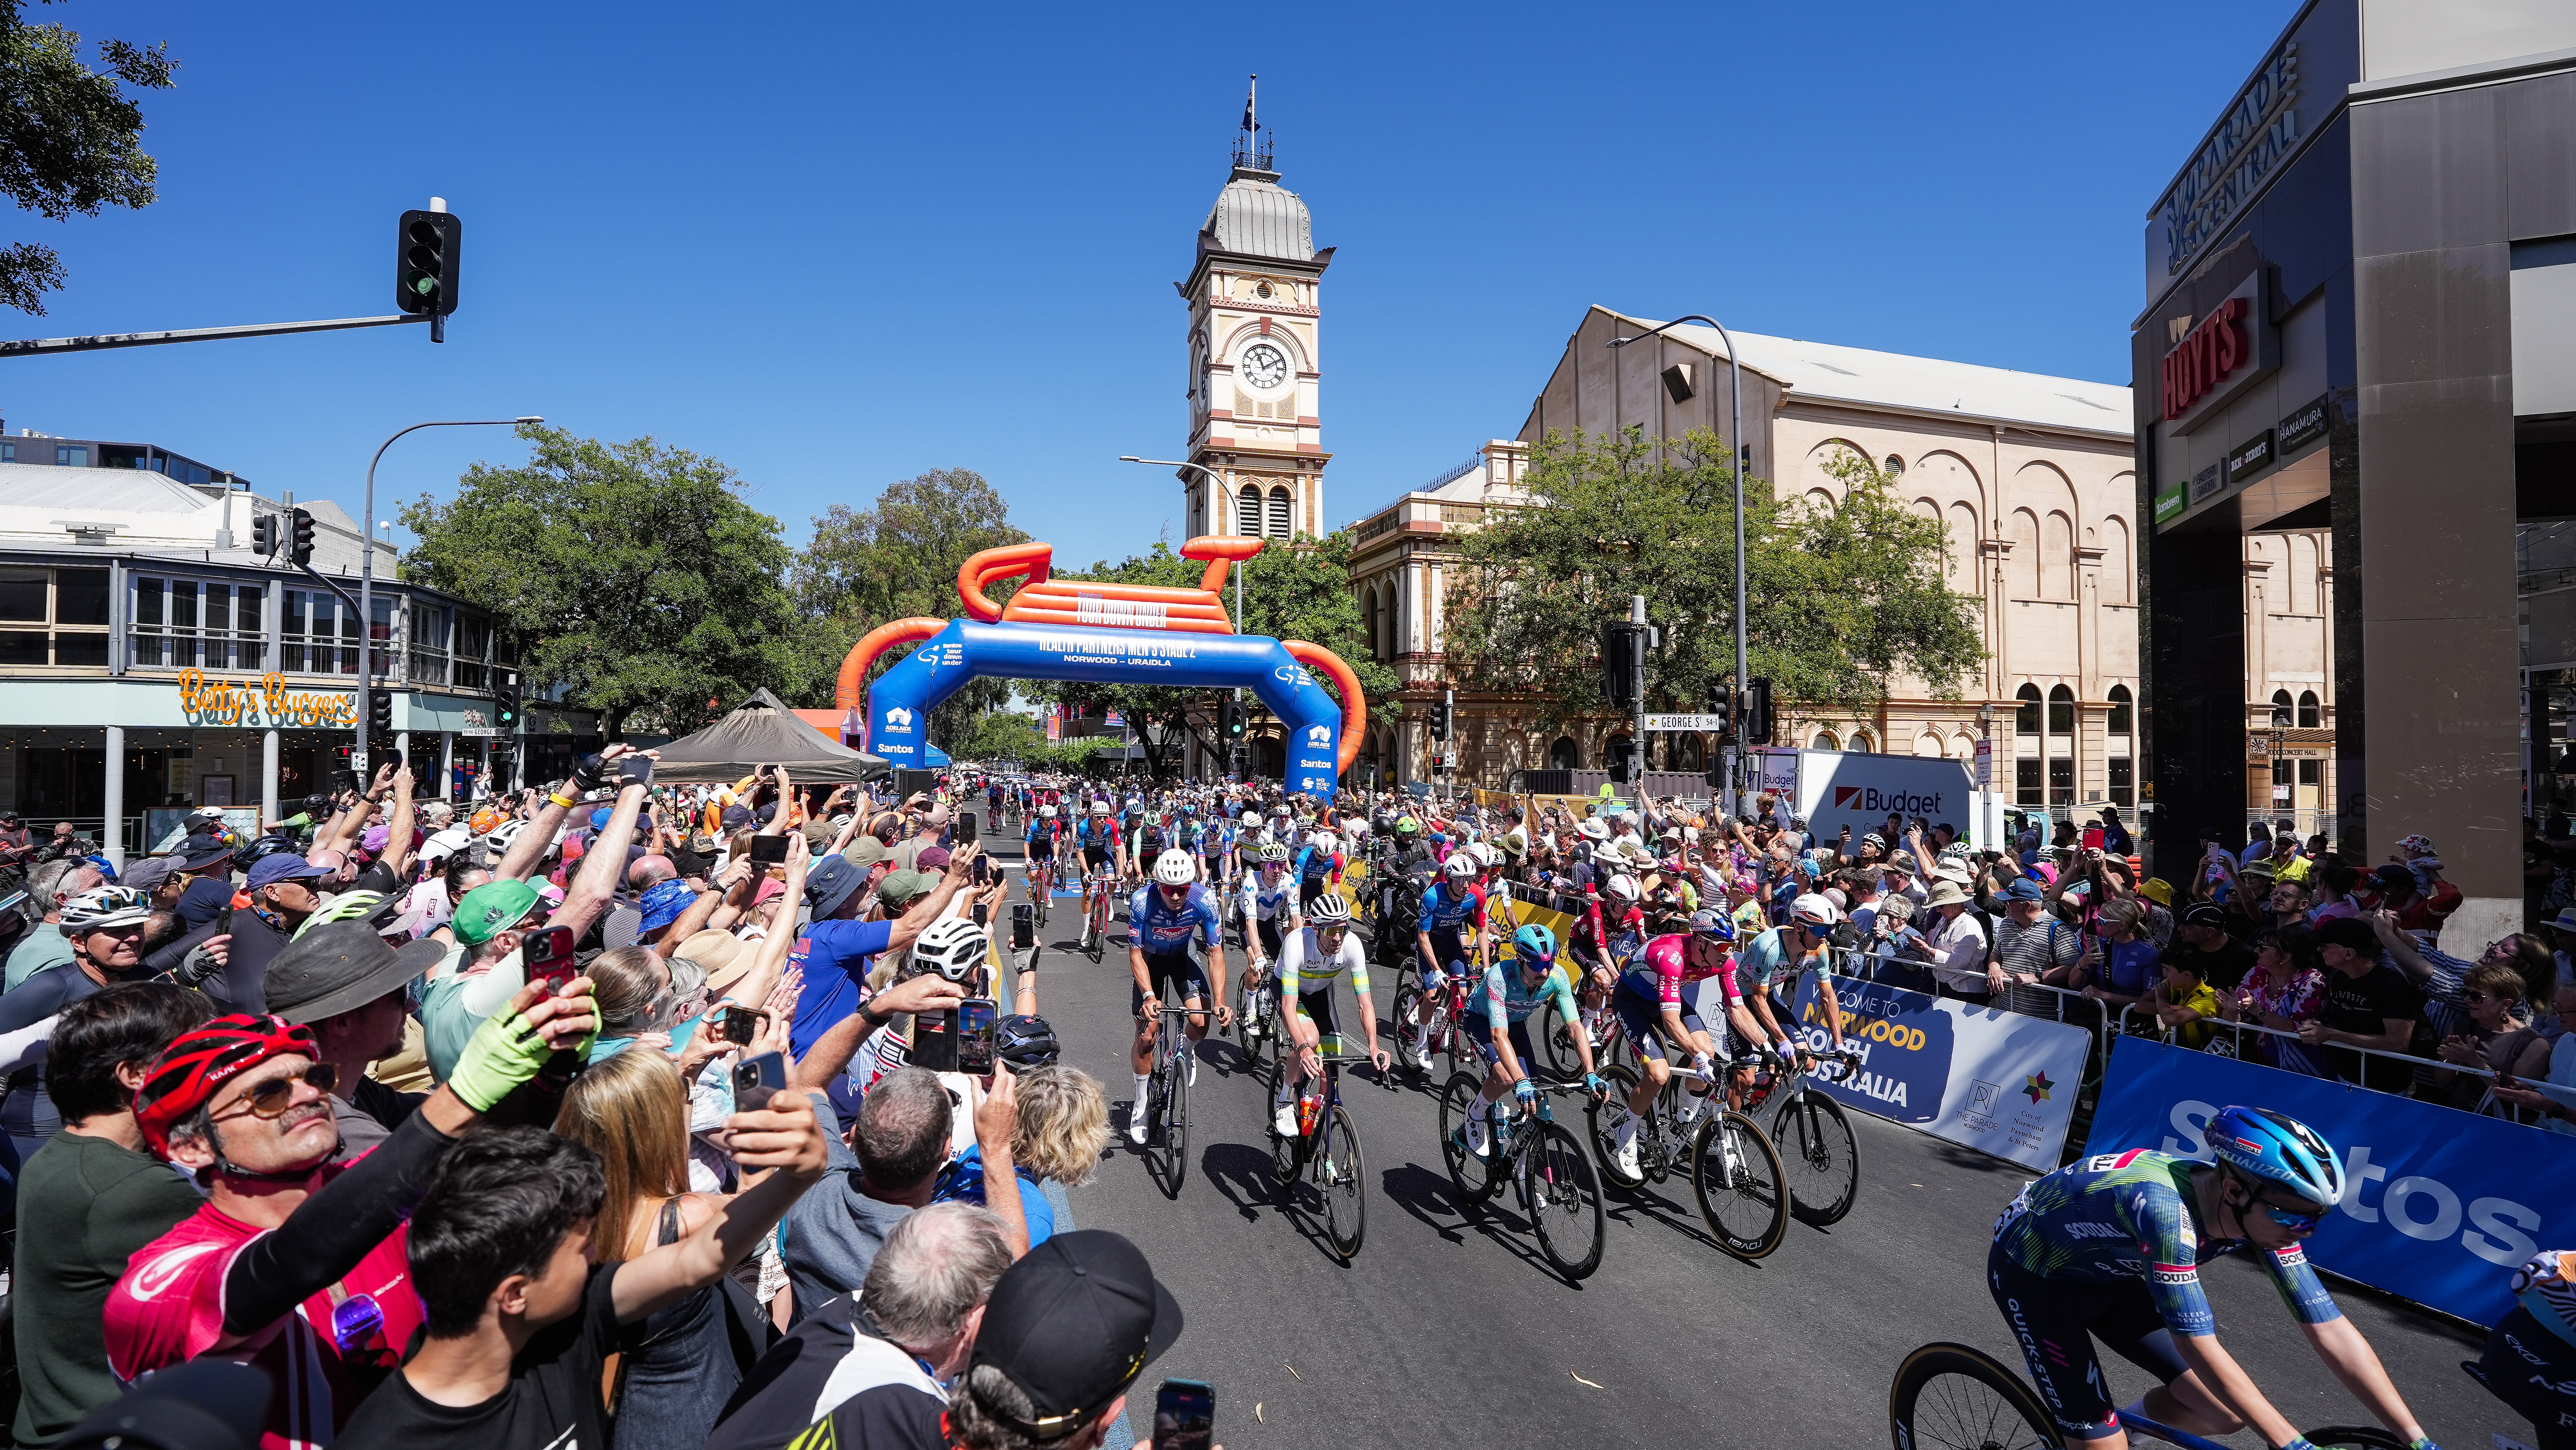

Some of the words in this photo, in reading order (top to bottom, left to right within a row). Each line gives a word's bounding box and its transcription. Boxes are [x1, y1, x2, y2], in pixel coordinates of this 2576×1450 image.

[2197, 42, 2297, 190] PARADE
[2199, 110, 2299, 239] CENTRAL
[2162, 297, 2247, 421] HOYTS
[2280, 407, 2324, 441] HANAMURA
[2231, 454, 2242, 472] BEN
[2245, 442, 2266, 464] JERRY'S
[2197, 463, 2217, 484] EASTERN
[2197, 477, 2216, 497] GARDEN
[2156, 494, 2179, 515] Zambrero
[1077, 599, 1102, 624] TOUR
[1103, 601, 1135, 626] DOWN
[1135, 603, 1167, 628] UNDER
[1039, 636, 1073, 653] HEALTH
[1077, 638, 1125, 656] PARTNERS
[1127, 639, 1158, 657] MEN'S
[1159, 640, 1188, 658] STAGE
[1189, 641, 1196, 658] 2
[1064, 655, 1117, 664] NORWOOD
[1128, 658, 1171, 667] URAIDLA
[178, 668, 258, 725] Betty's
[262, 672, 358, 725] Burgers
[1662, 717, 1692, 727] GEORGE
[878, 743, 913, 753] Santos
[1300, 759, 1331, 768] Santos
[1764, 774, 1794, 787] Budget
[1866, 788, 1941, 818] Budget
[1132, 892, 1147, 910] PREMIER
[1135, 900, 1144, 913] TECH
[489, 924, 505, 936] CYCLING
[505, 917, 515, 928] CLUB
[501, 912, 516, 924] POINT
[1156, 927, 1189, 936] Alpecin
[1668, 951, 1680, 964] BORA
[1625, 963, 1652, 976] hansgrohe
[1398, 988, 1409, 997] MICHE
[1671, 975, 1679, 997] BOSS
[1882, 1000, 1900, 1017] TO
[1616, 1011, 1632, 1039] BORA
[210, 1064, 237, 1082] KASK
[1956, 1111, 1969, 1122] THE
[1971, 1115, 1999, 1131] PARADE
[2021, 1110, 2034, 1120] City
[1710, 1121, 1743, 1132] rval
[1963, 1123, 1985, 1133] NORWOOD
[2013, 1118, 2044, 1132] Norwood
[2011, 1127, 2041, 1142] Payneham
[2022, 1141, 2039, 1151] Peters
[2235, 1142, 2260, 1155] SOUDAL
[2214, 1144, 2296, 1181] SPECIALIZED
[2161, 1100, 2541, 1268] Stos
[2065, 1222, 2130, 1239] SOUDAL
[1728, 1238, 1762, 1250] roval
[2155, 1272, 2198, 1282] SOUDA
